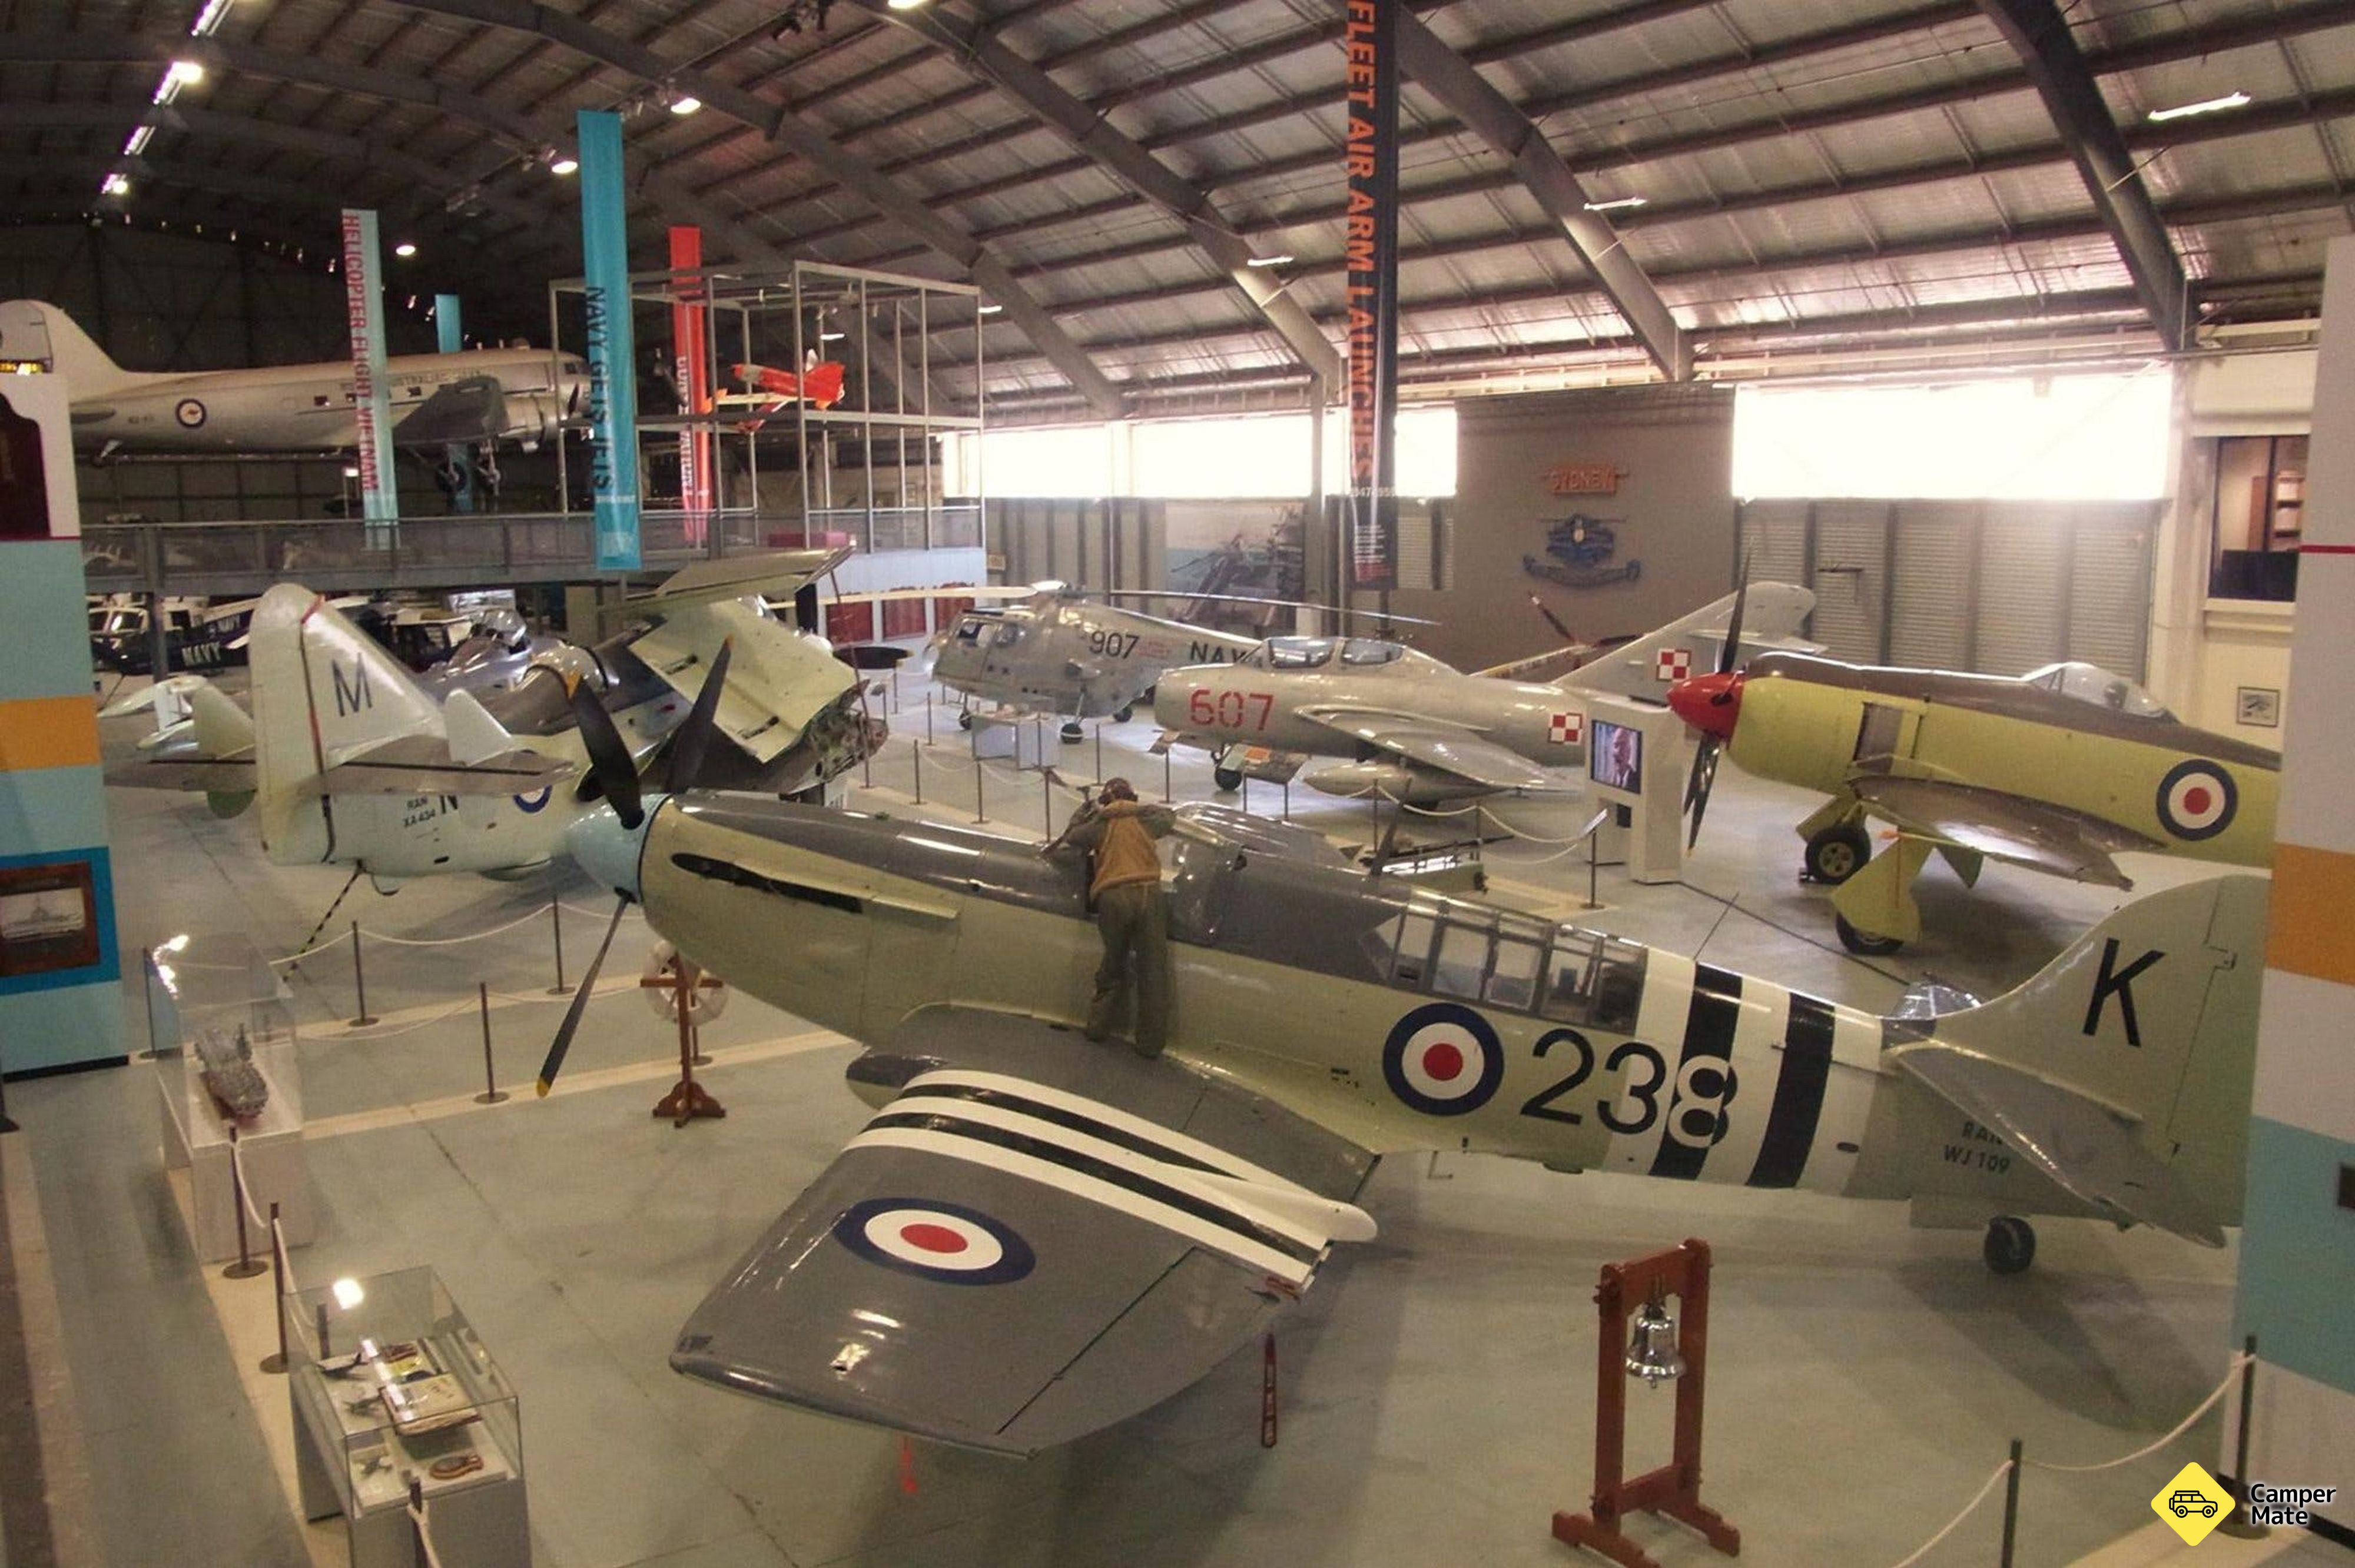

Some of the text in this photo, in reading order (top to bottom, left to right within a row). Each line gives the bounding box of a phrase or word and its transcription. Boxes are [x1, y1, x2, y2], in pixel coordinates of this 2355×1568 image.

[1347, 0, 1375, 109] FLEET
[1347, 115, 1375, 179] AIR
[1347, 188, 1375, 272] ARM
[586, 287, 607, 348] NAVY
[343, 215, 379, 490] HELICOPTER FLIGHT VIETNAM
[1347, 286, 1375, 478] LAUNCHES
[591, 360, 607, 424] GETS
[182, 642, 221, 666] NAVY
[1090, 630, 1140, 659] 907
[331, 652, 373, 717] M
[1190, 689, 1274, 731] 607
[2082, 937, 2166, 1048] K
[1520, 1028, 1738, 1148] 238
[1978, 1152, 2011, 1174] 109
